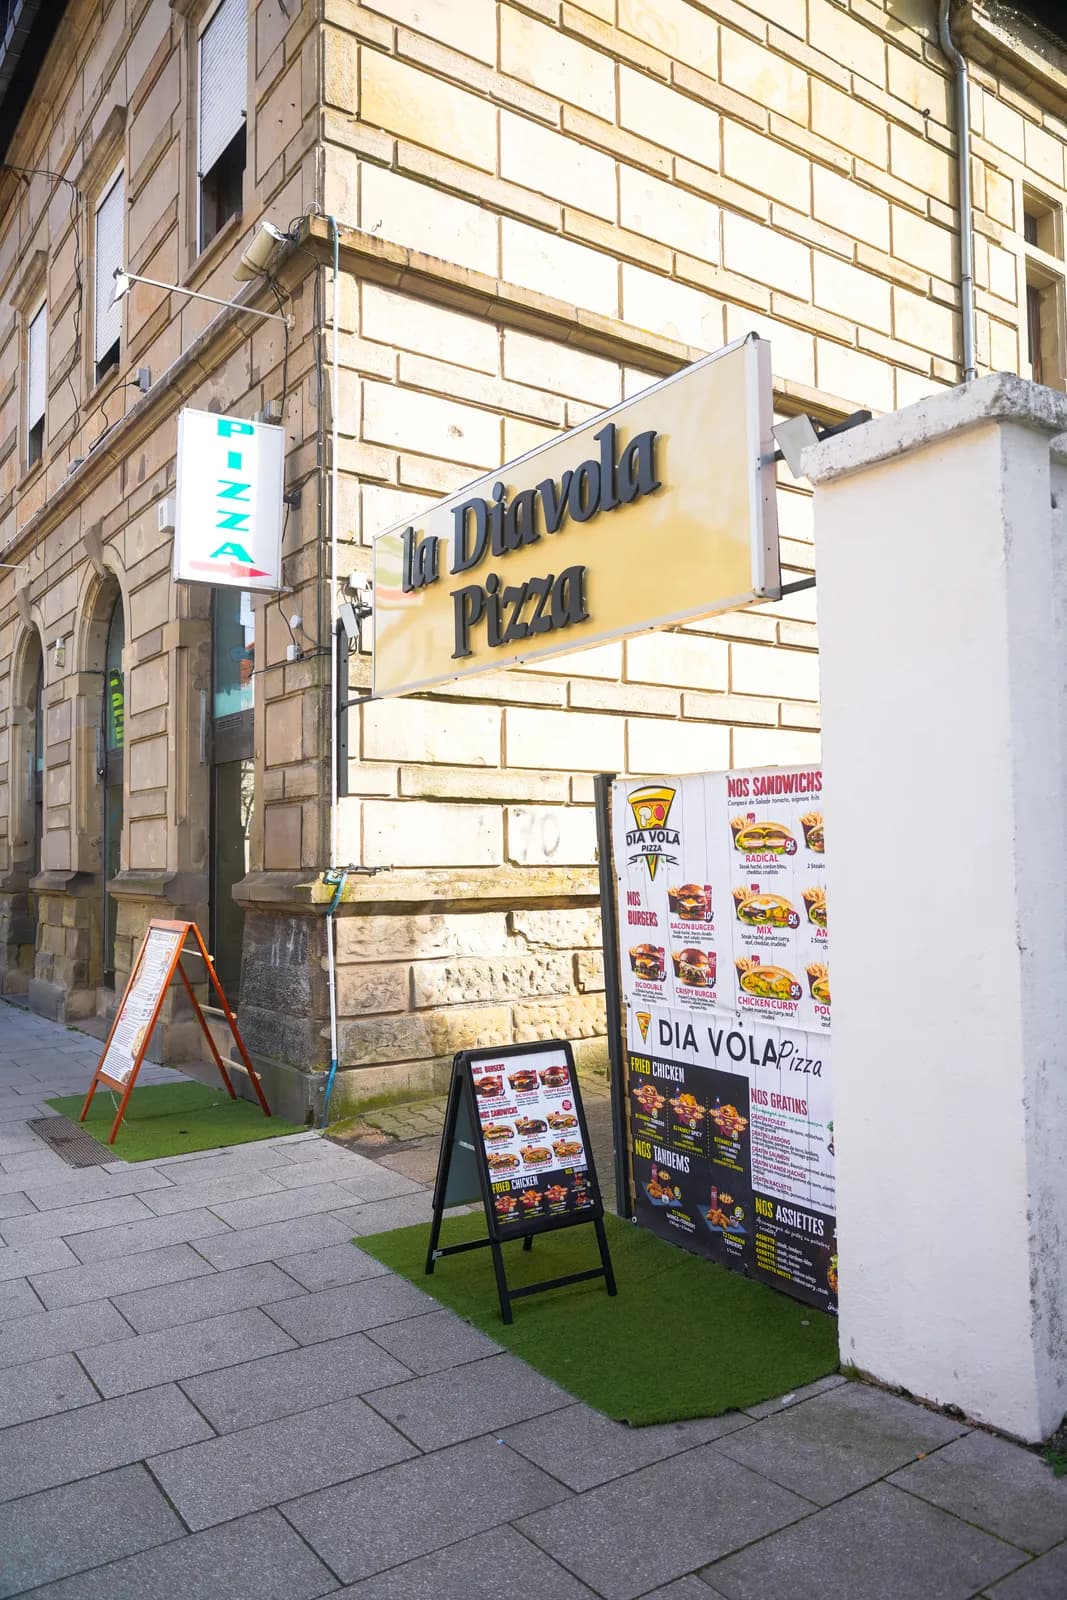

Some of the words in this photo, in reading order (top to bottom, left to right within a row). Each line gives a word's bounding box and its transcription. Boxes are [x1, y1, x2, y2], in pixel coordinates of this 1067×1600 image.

[210, 418, 255, 563] PIZZA
[400, 526, 440, 593] la
[449, 423, 662, 575] Diavola
[449, 564, 590, 659] Pizza
[728, 778, 750, 797] NOS
[753, 771, 822, 796] SANDWICHS
[626, 832, 645, 846] DIA
[649, 831, 680, 846] VOLA
[745, 854, 779, 863] RADICAL
[627, 890, 641, 906] NOS
[628, 910, 658, 927] BURGERS
[671, 922, 690, 930] BACON
[691, 923, 715, 931] BURGER
[757, 926, 772, 935] MIX
[643, 982, 663, 991] DOUBLE
[676, 987, 694, 996] CRISPY
[694, 990, 717, 999] BURGER
[737, 996, 770, 1008] CHICKEN
[771, 1000, 799, 1011] CURRY
[659, 1019, 699, 1053] DIA
[708, 1027, 778, 1069] VOLA
[776, 1039, 823, 1077] Pizza
[630, 1056, 650, 1075] FRIED
[652, 1061, 684, 1083] CHICKEN
[751, 1088, 768, 1106] NOS
[770, 1093, 807, 1115] GRATINS
[635, 1139, 651, 1159] NOS
[653, 1145, 690, 1173] TANDEMS
[491, 1181, 510, 1194] FRIED
[511, 1175, 538, 1190] CHICKEN
[755, 1197, 773, 1218] NOS
[776, 1205, 824, 1236] ASSIETTES
